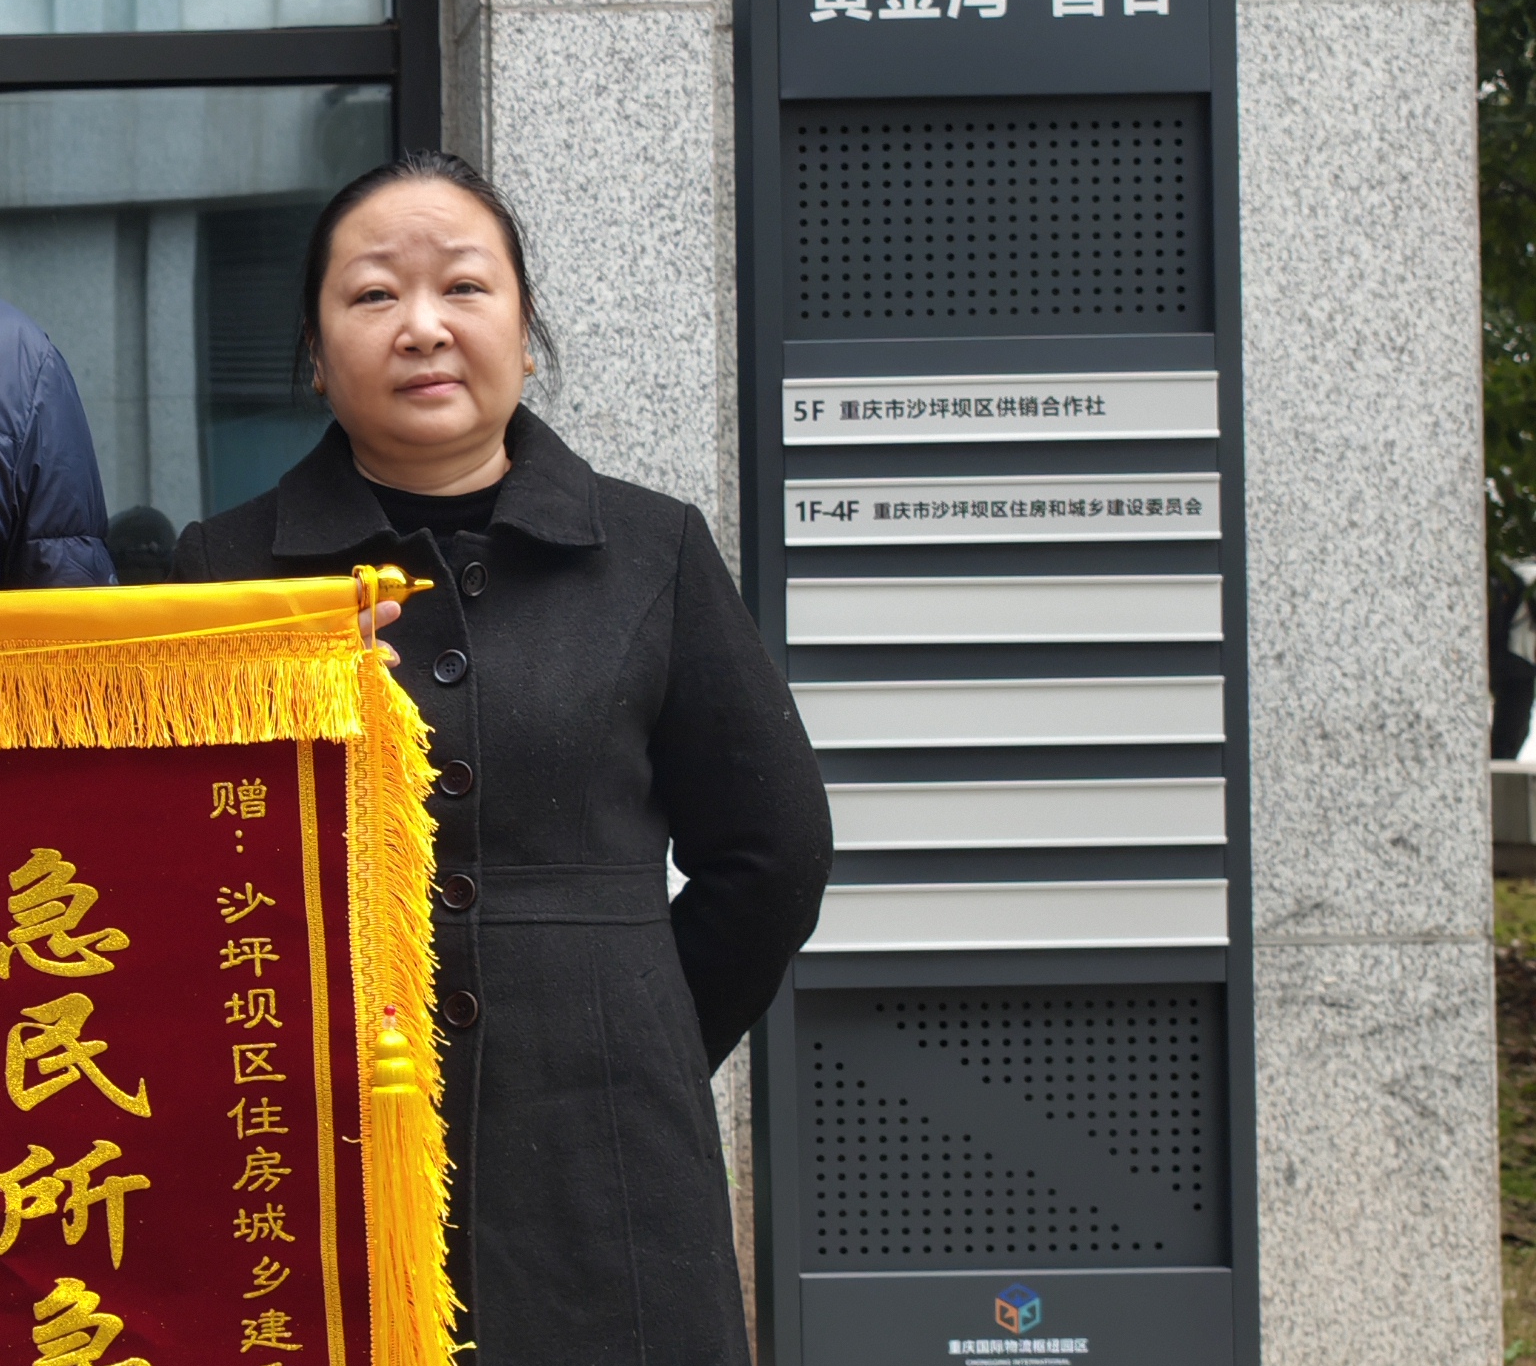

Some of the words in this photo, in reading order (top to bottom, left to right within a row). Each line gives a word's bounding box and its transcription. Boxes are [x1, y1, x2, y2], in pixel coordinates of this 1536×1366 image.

[794, 400, 825, 421] 5F
[840, 396, 1106, 421] 重庆市沙坪坝区供销合作社
[796, 501, 860, 522] 1F-4F
[874, 498, 1202, 520] 重庆市沙坪坝区住房和城乡建设委员会
